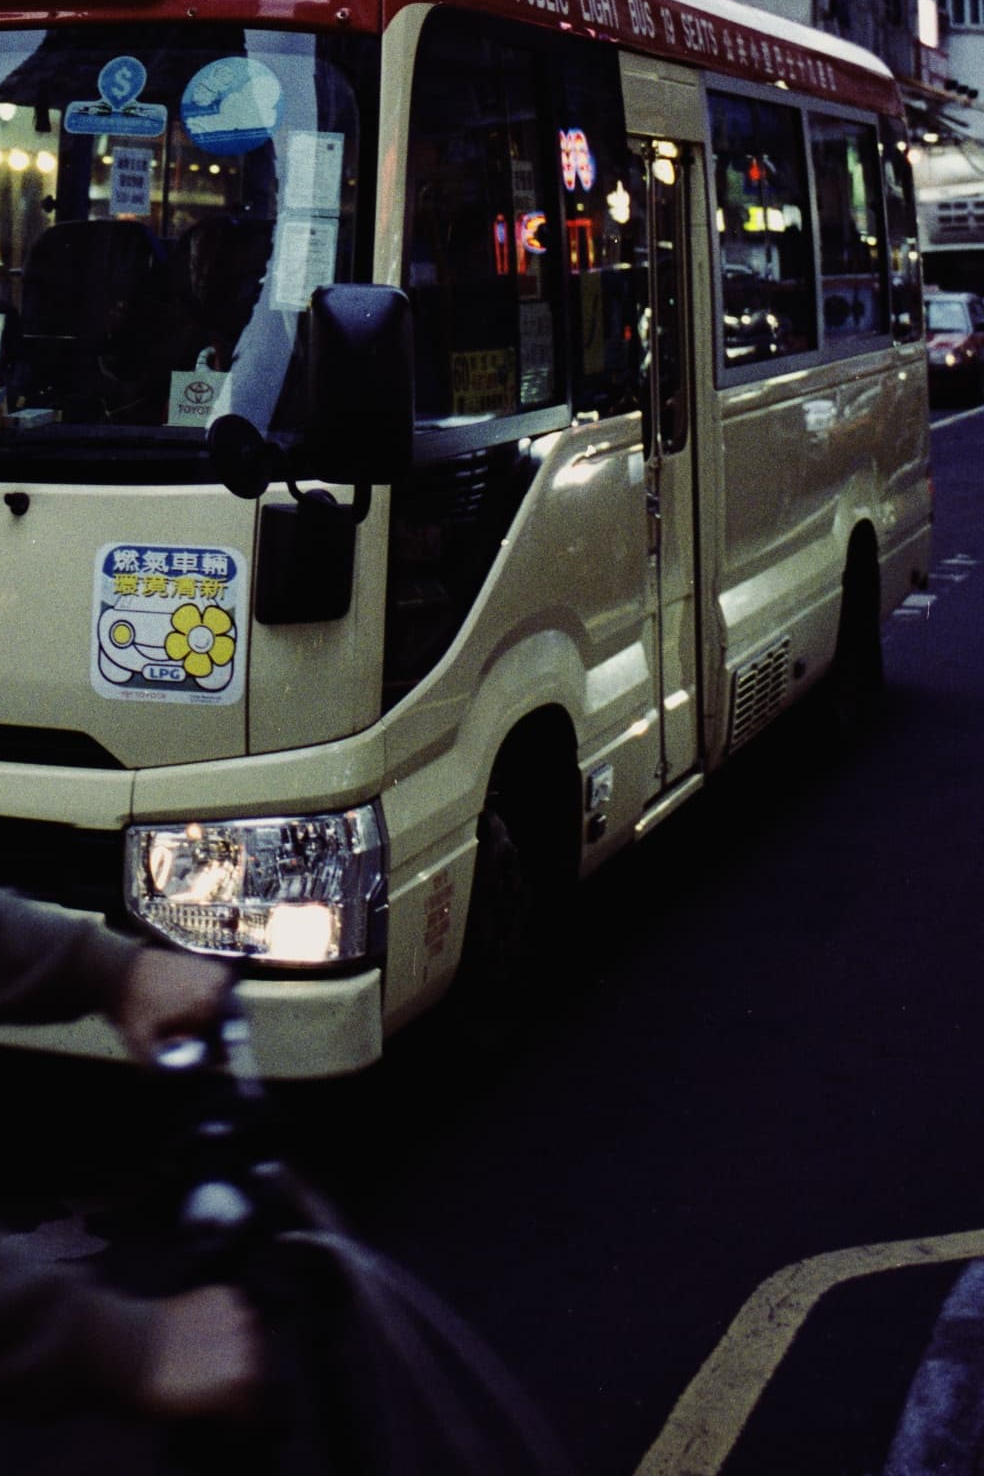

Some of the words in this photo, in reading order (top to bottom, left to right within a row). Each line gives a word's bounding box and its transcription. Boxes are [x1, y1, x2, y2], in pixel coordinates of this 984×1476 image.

[680, 12, 719, 56] SEATS
[178, 404, 212, 416] TOYOT
[113, 548, 229, 576] 燃氣車輛
[149, 667, 181, 680] LPG
